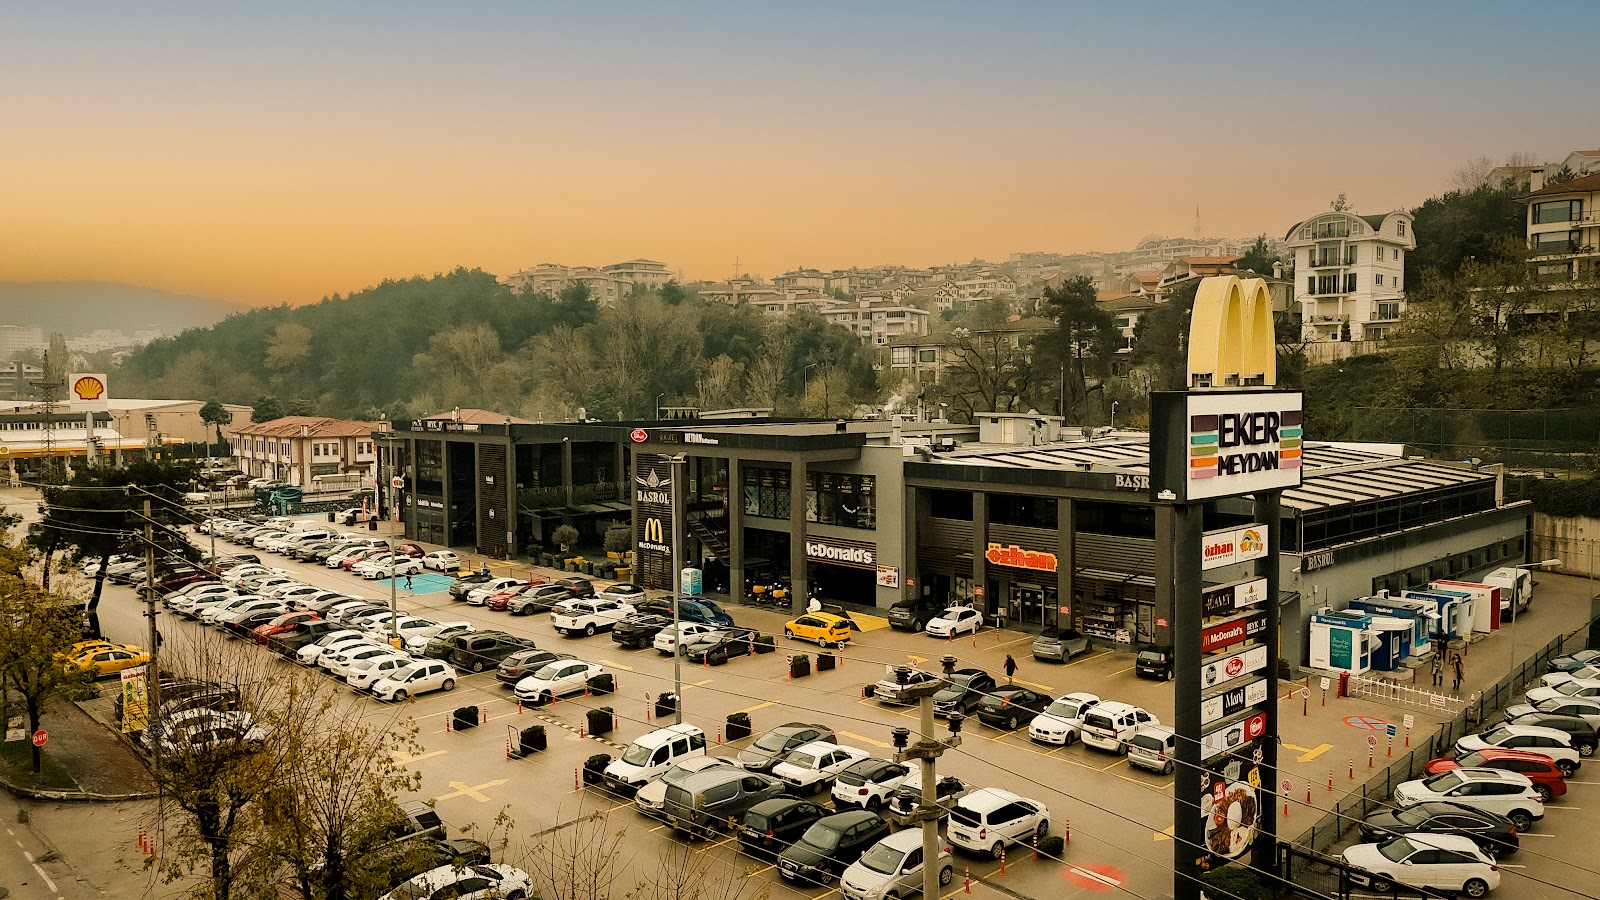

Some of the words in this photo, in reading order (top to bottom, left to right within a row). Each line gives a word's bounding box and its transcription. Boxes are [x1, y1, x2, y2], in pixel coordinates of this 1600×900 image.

[1219, 412, 1279, 447] EKER
[1218, 451, 1279, 476] MEYDAN
[1115, 475, 1150, 492] BAŞR
[638, 542, 671, 552] McDonald's
[1205, 543, 1233, 557] özhan
[985, 543, 1057, 572] özhan
[1210, 627, 1243, 643] McDonald's
[33, 733, 47, 743] DUR
